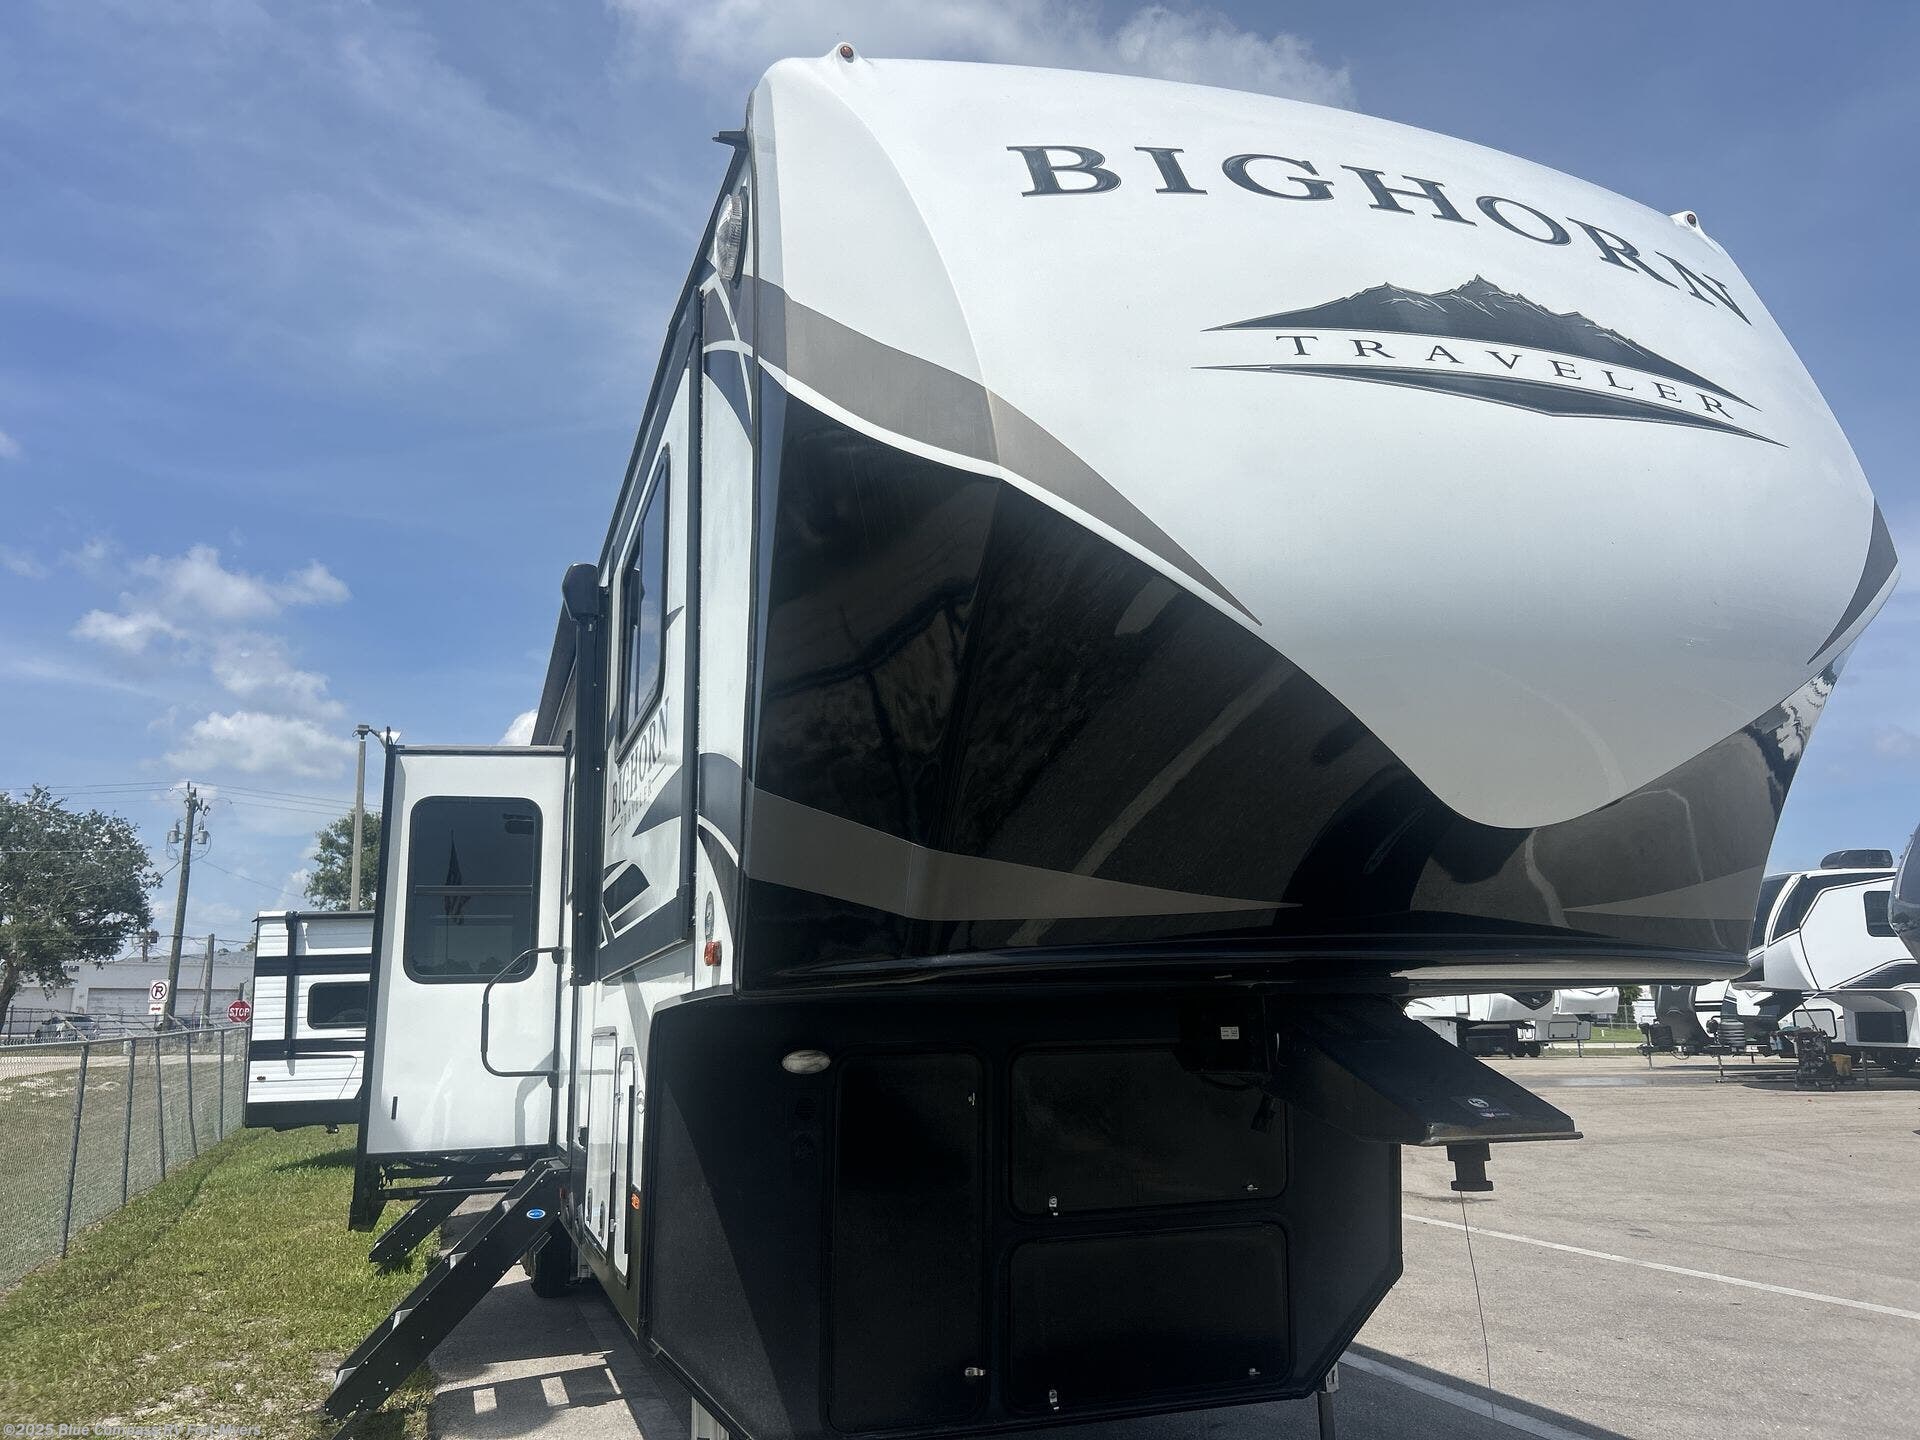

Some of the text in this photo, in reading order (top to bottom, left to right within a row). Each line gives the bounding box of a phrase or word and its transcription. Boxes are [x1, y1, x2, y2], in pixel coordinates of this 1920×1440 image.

[1006, 145, 1752, 326] BIGHORN
[1274, 334, 1736, 419] TRAVELER
[612, 696, 669, 823] BIGHORN
[229, 1007, 249, 1017] STOP
